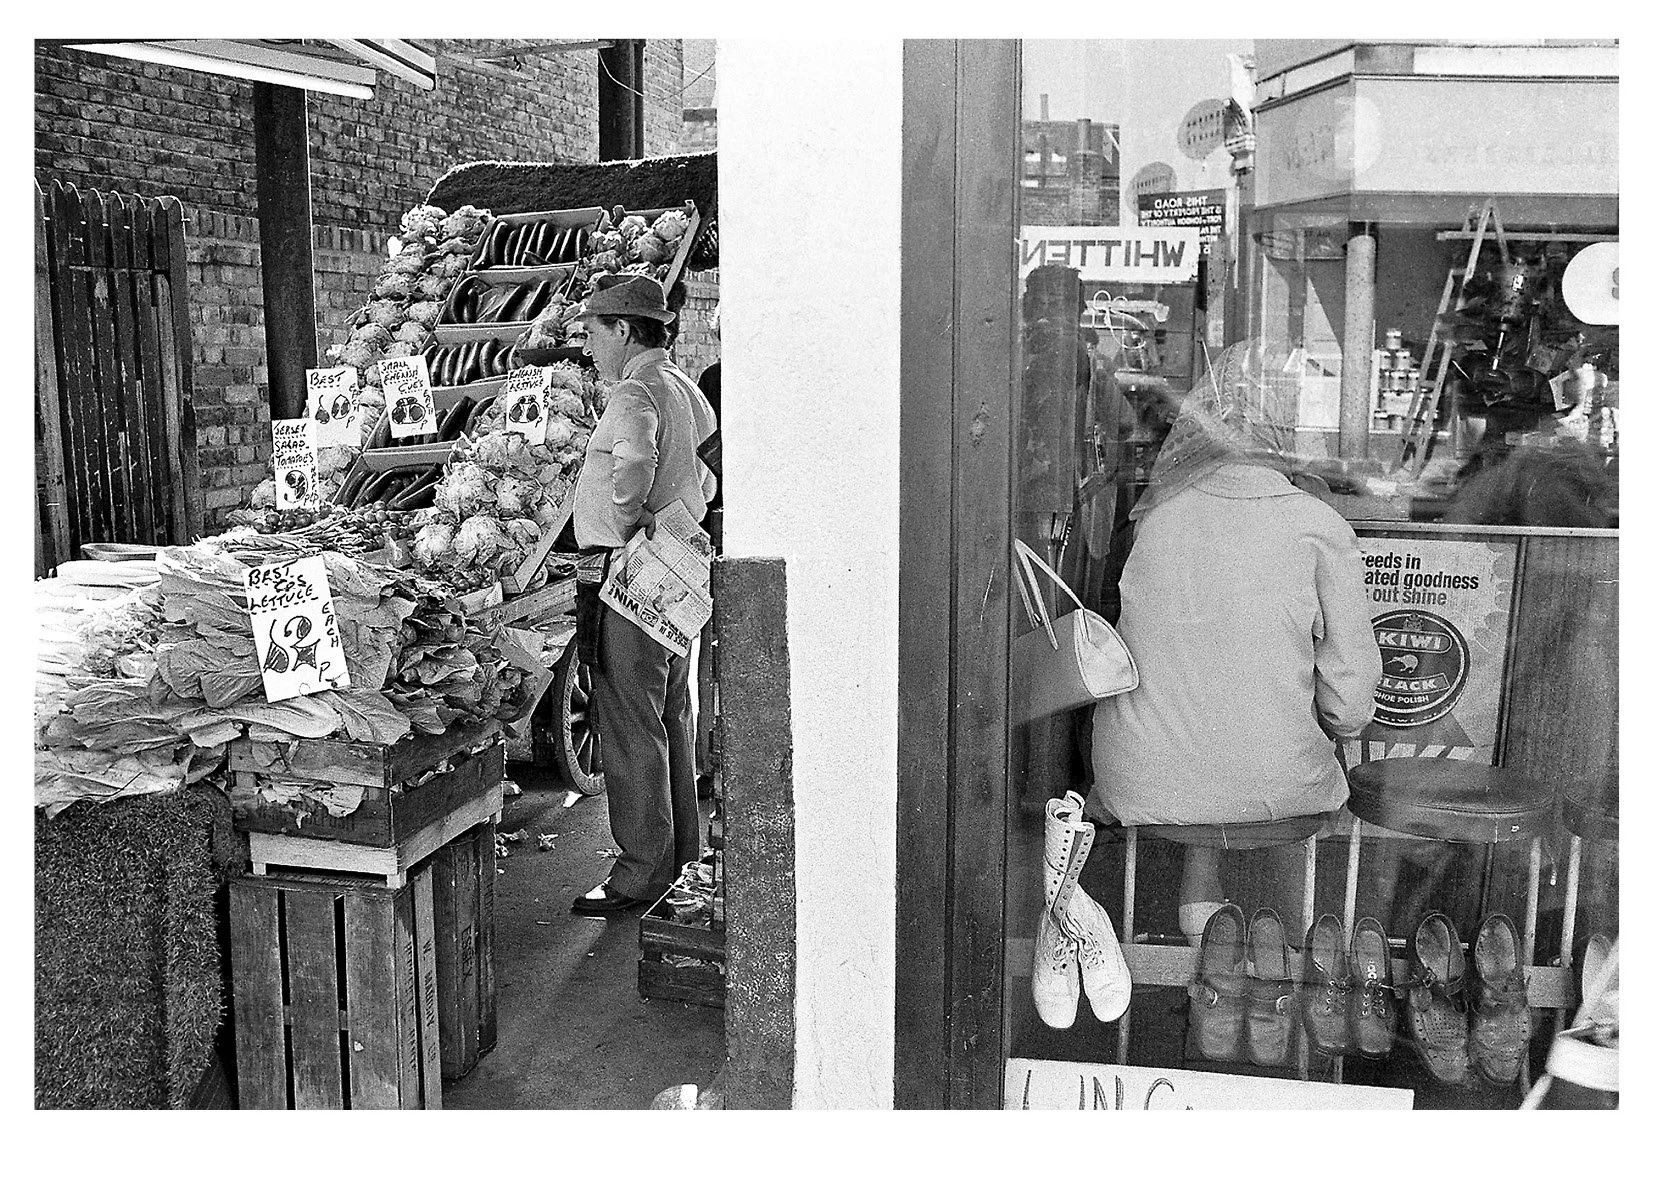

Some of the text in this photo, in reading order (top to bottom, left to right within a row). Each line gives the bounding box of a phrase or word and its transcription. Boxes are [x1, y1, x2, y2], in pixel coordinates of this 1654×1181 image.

[381, 361, 409, 371] SMALL
[509, 368, 543, 380] ENGLISH
[310, 370, 346, 386] BEST
[273, 421, 307, 435] JERSEY
[1362, 552, 1421, 569] eeds in
[248, 559, 298, 587] BEST
[1364, 570, 1479, 590] ated goodness
[274, 575, 307, 593] COS
[250, 584, 313, 611] LETTUCE
[1372, 588, 1400, 602] out
[1402, 589, 1447, 606] shine
[322, 602, 339, 648] EACH
[1378, 632, 1441, 650] KIWI
[1378, 678, 1437, 691] LACK
[1373, 691, 1429, 704] SHOE POLISH
